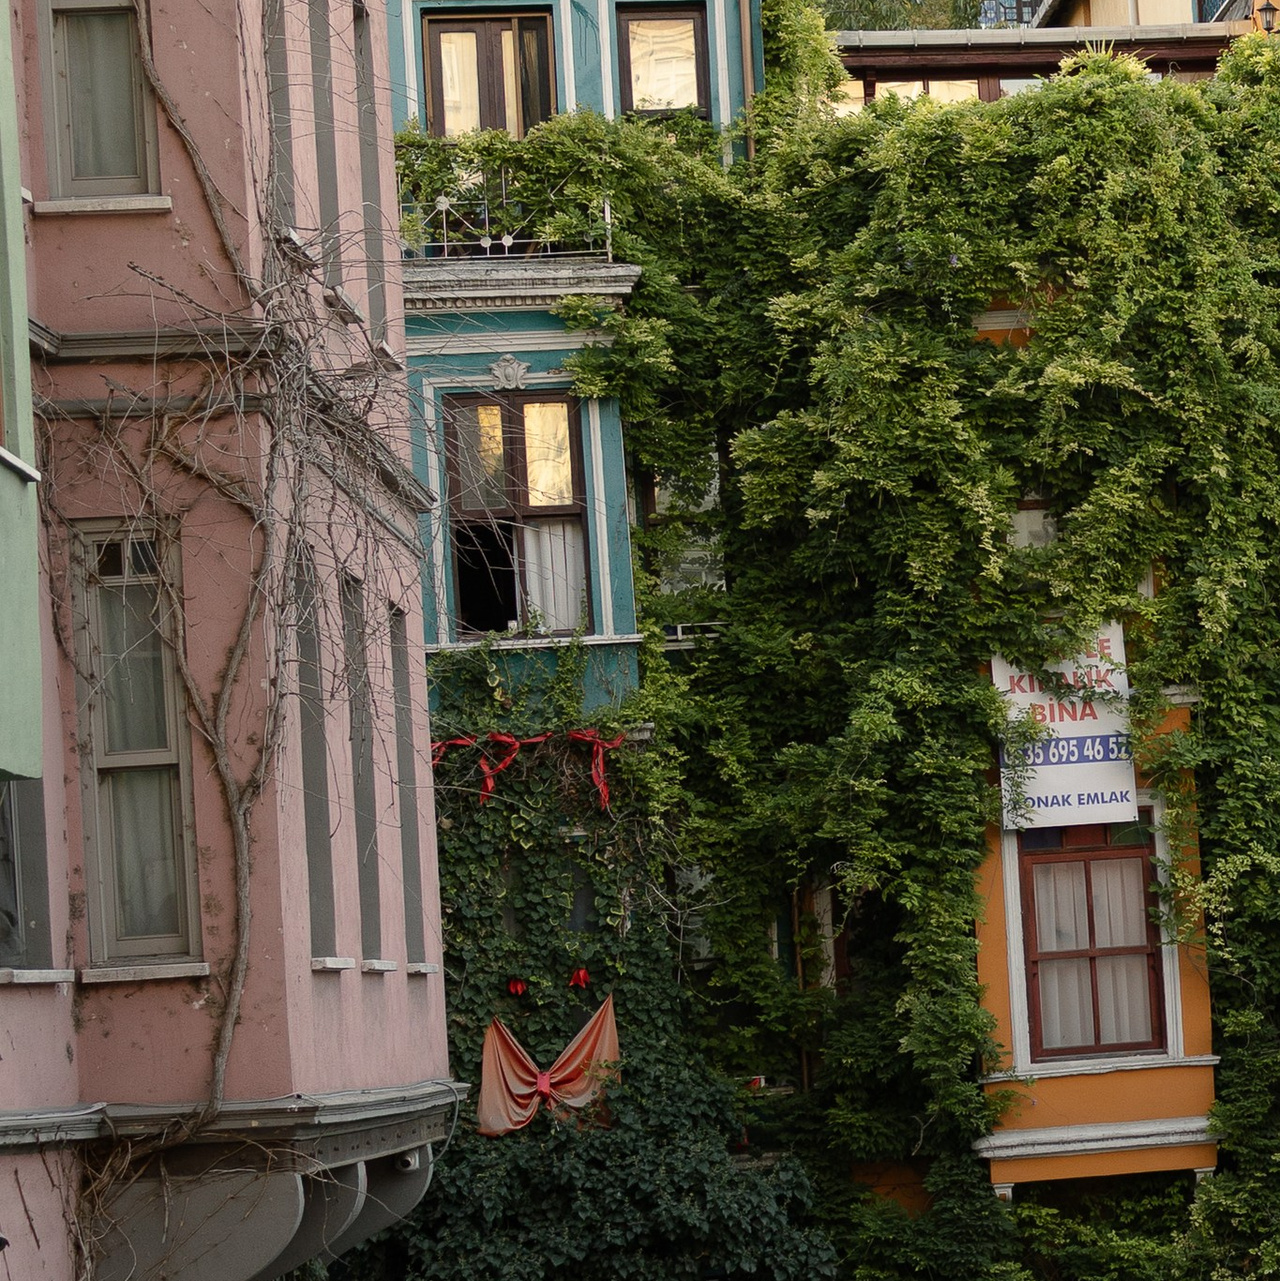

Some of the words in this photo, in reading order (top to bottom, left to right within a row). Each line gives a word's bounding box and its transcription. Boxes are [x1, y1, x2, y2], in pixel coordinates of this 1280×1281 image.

[1032, 697, 1098, 723] BİNA
[1048, 739, 1079, 764] 695
[1083, 738, 1104, 761] 46
[1017, 794, 1073, 809] ONAK
[1077, 790, 1131, 806] EMLAK
